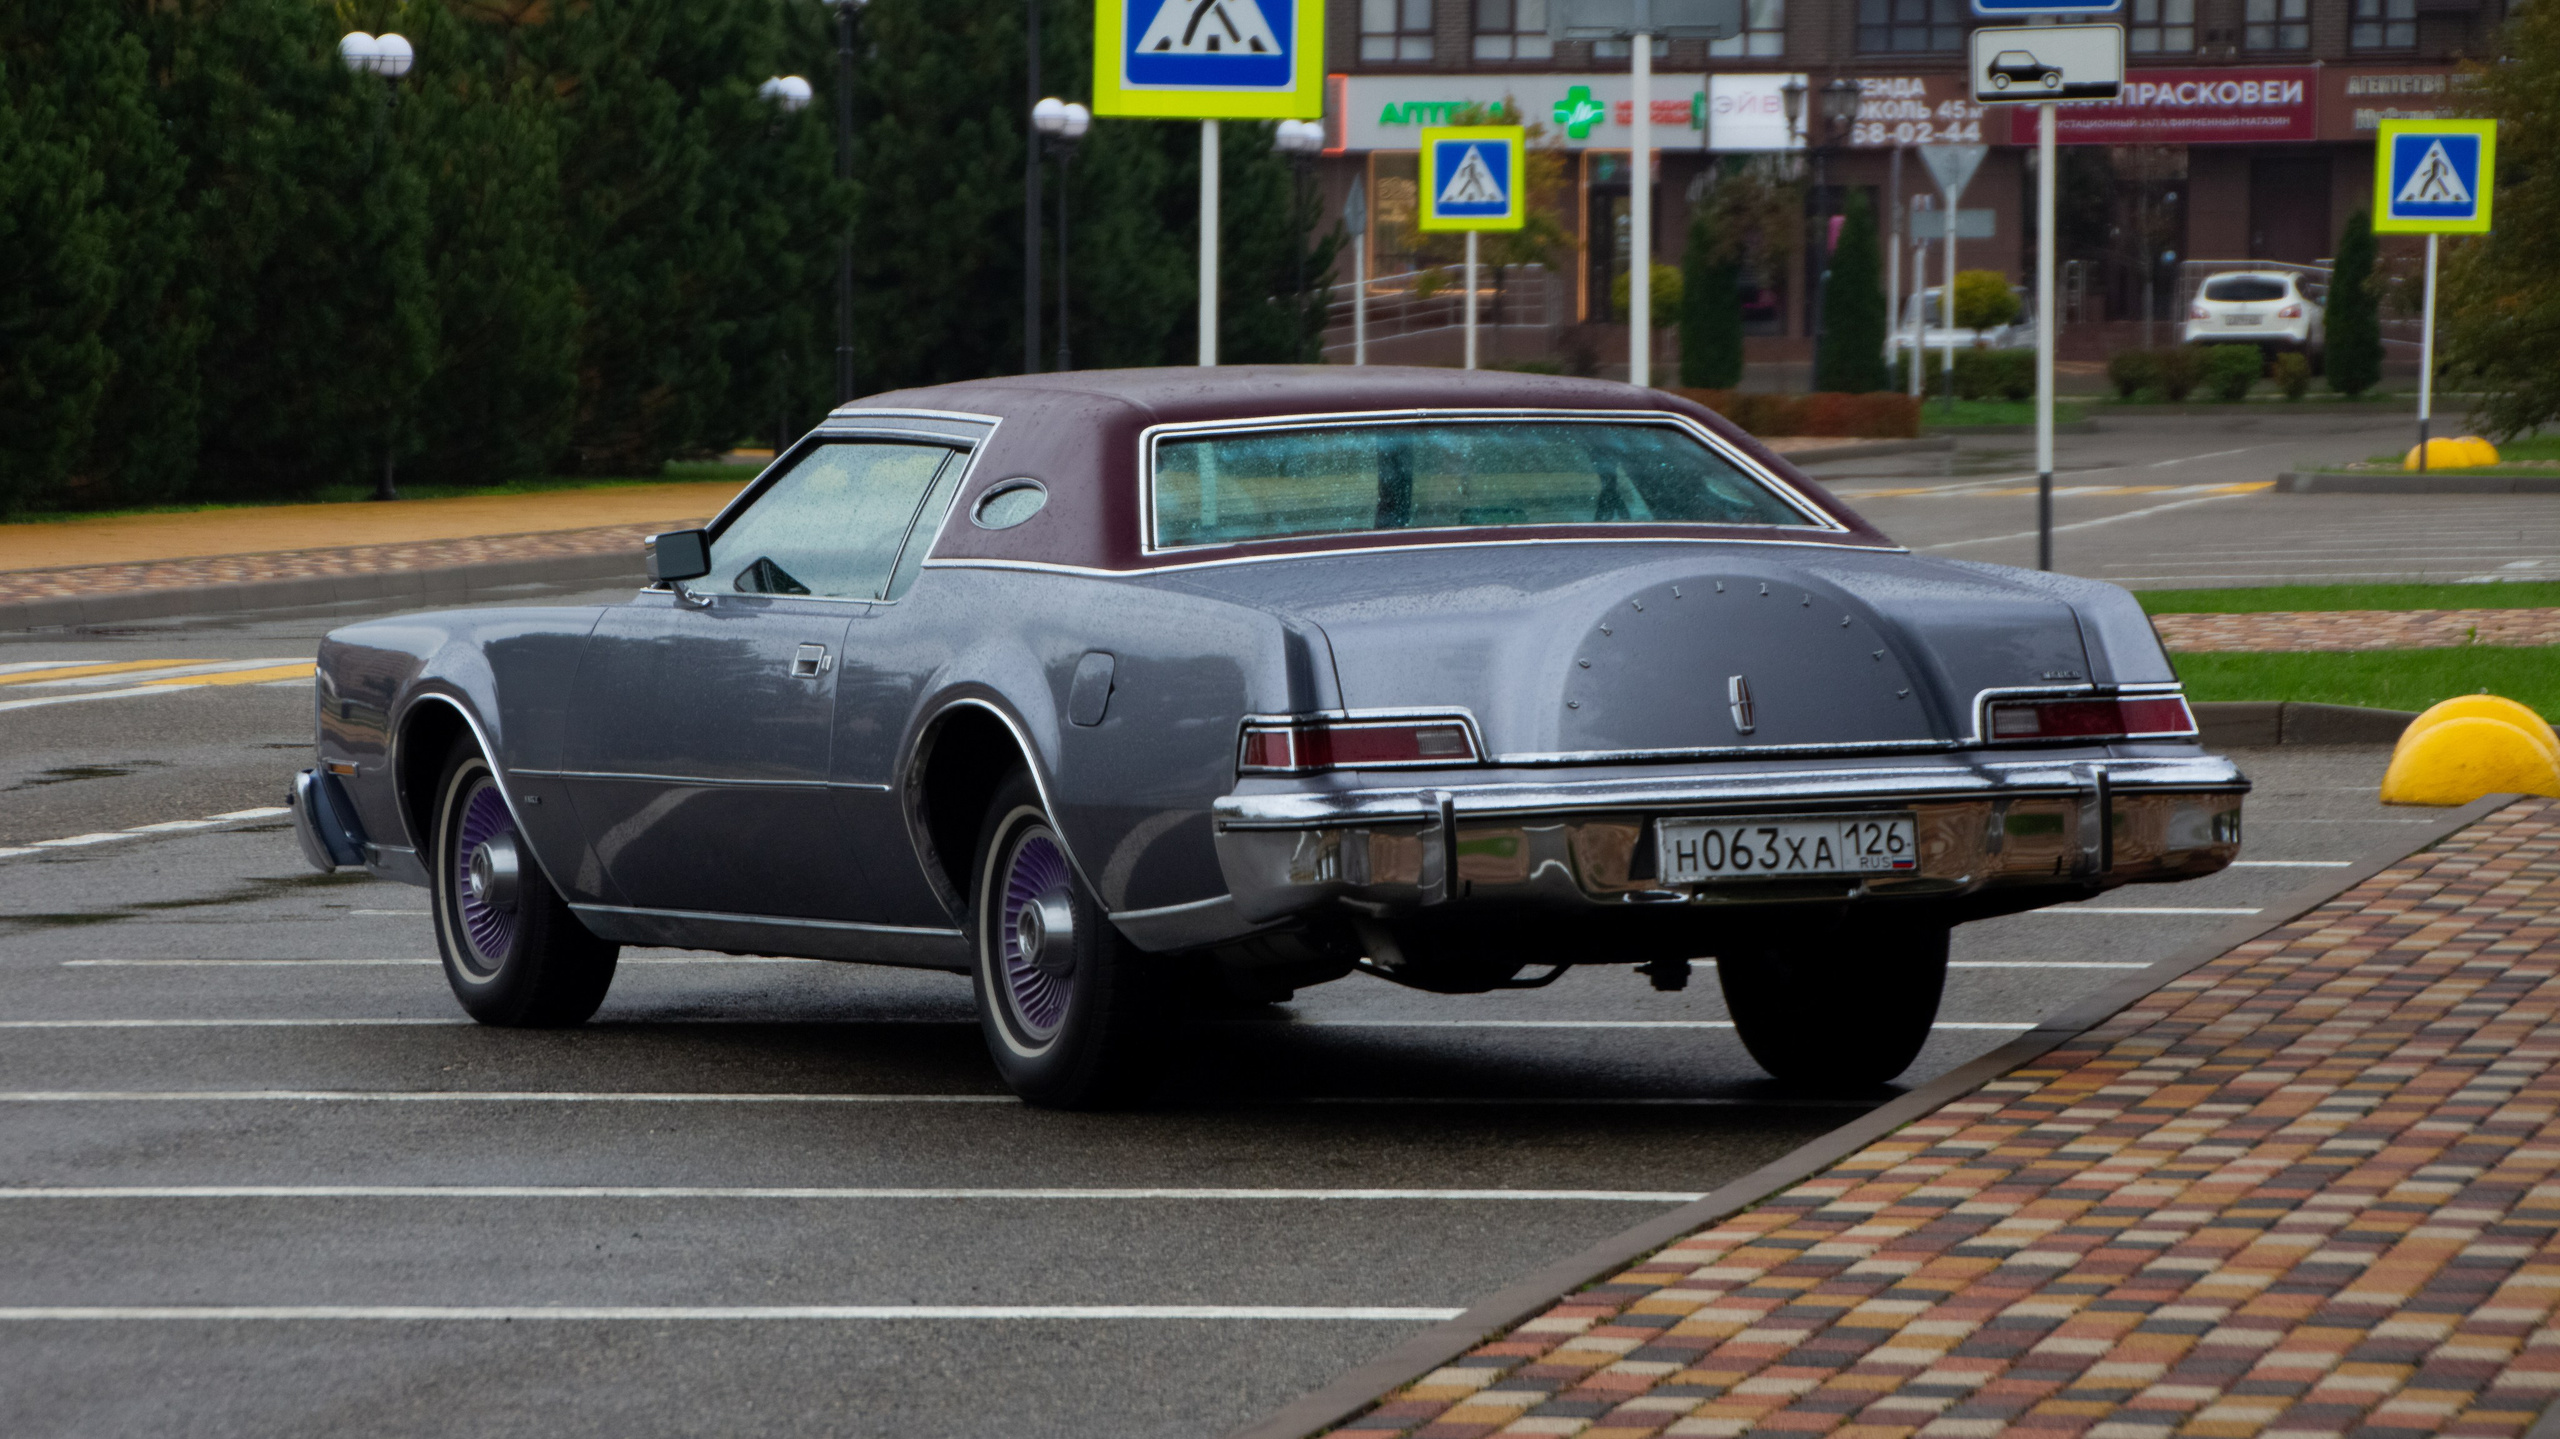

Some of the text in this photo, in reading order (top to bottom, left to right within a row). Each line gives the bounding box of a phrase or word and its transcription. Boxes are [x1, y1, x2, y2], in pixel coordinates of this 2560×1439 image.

[1857, 77, 1926, 97] ЕНДА
[1713, 91, 1783, 115] ЭЙВ
[1936, 99, 1967, 119] 45
[2241, 115, 2291, 127] МАГАЗИН
[1676, 821, 1904, 872] Н063ХА 126
[1860, 857, 1891, 869] RUS
